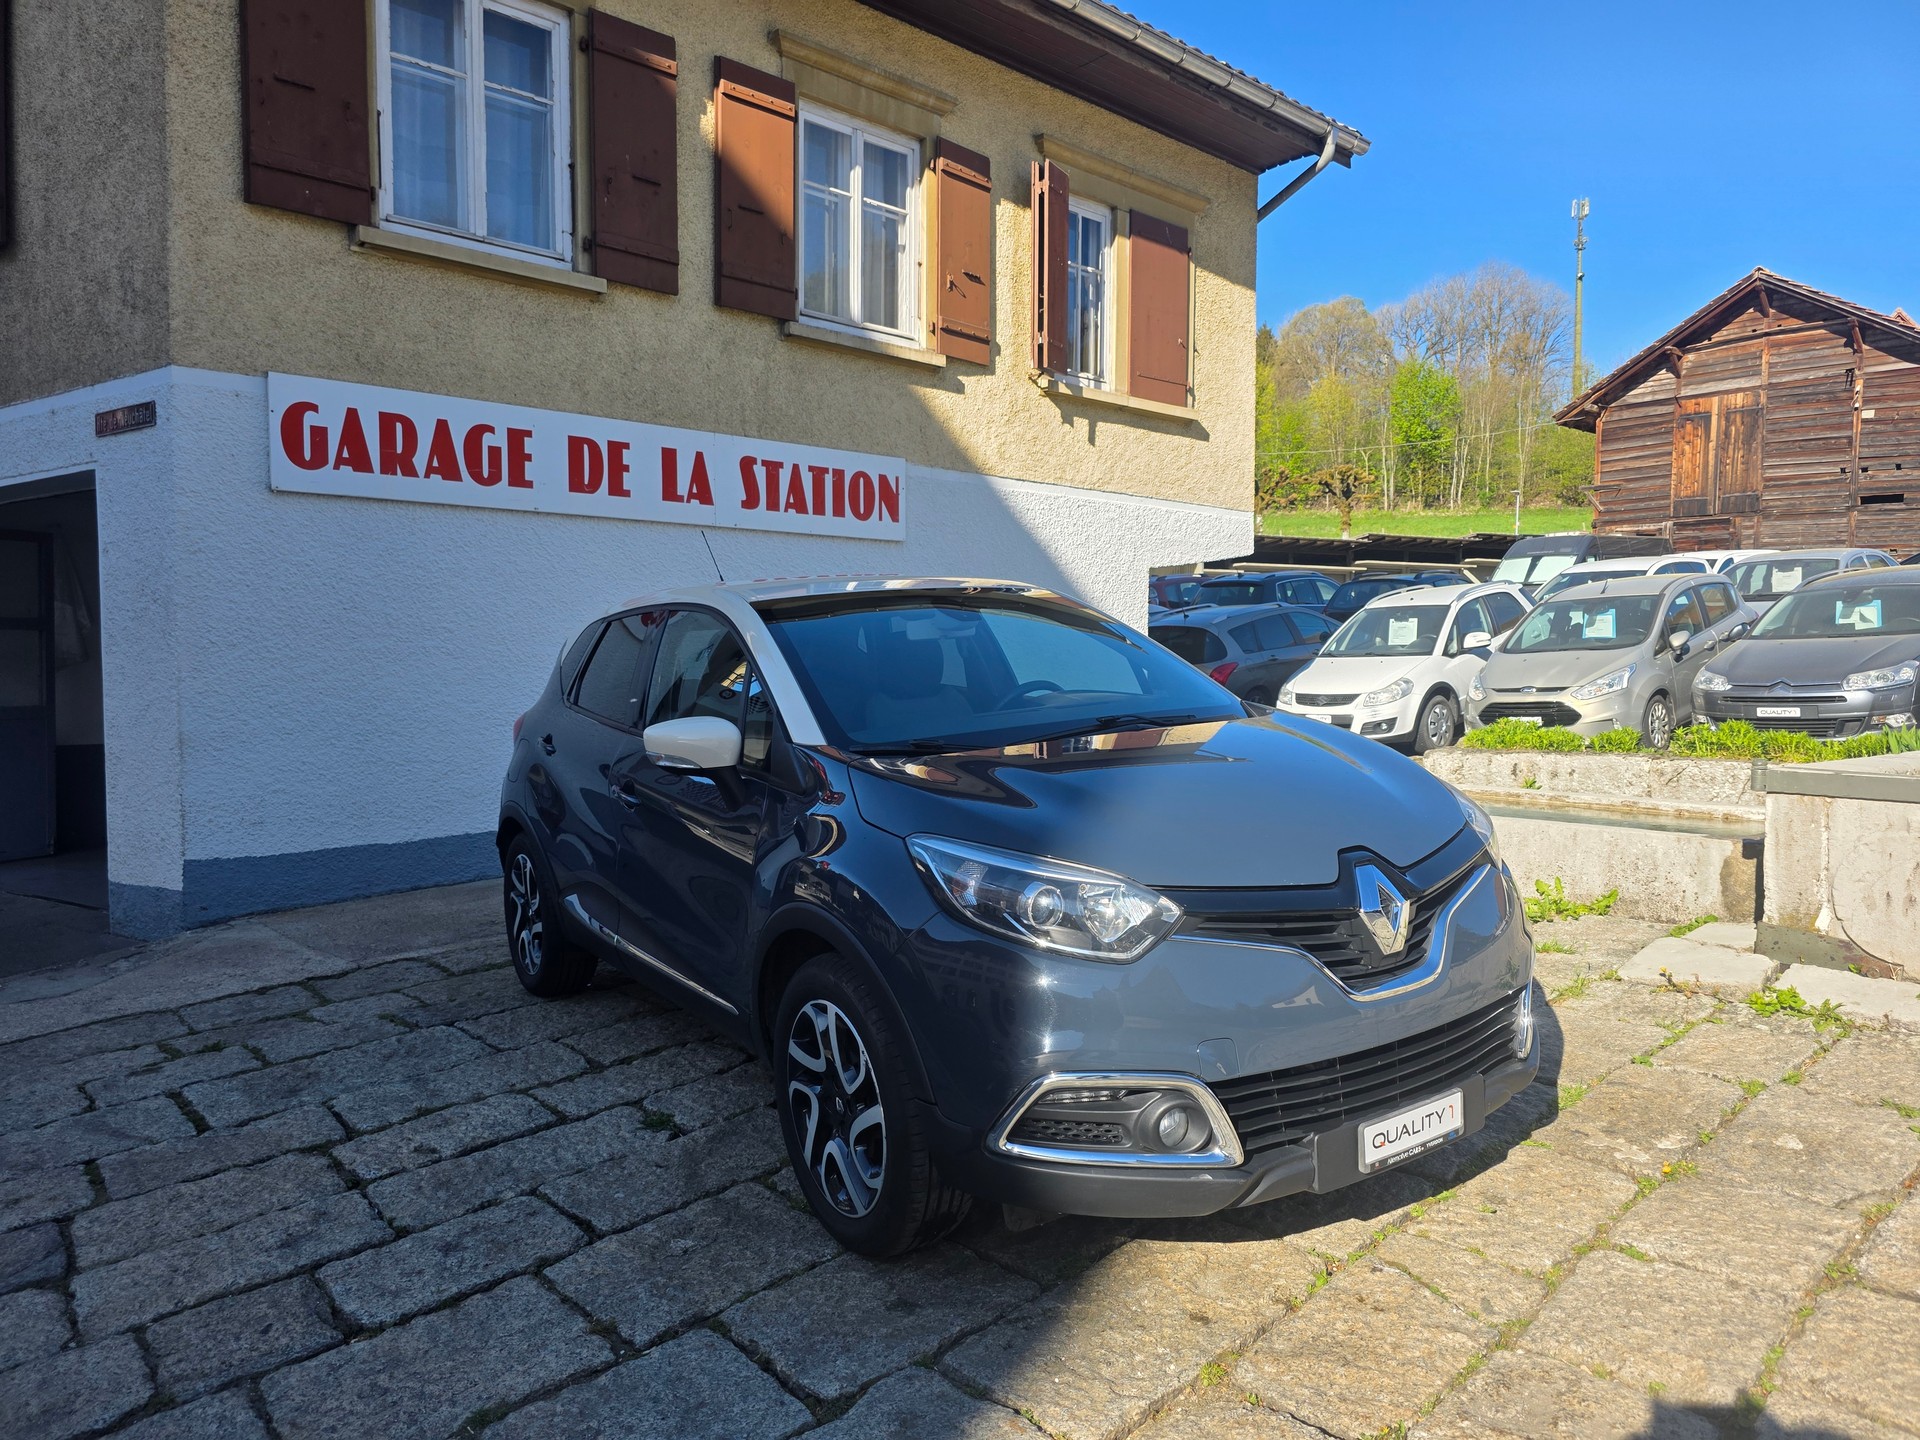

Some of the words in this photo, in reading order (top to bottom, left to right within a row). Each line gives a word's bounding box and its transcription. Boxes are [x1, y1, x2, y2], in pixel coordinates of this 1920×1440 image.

[280, 401, 534, 488] GARAGE
[567, 435, 631, 498] DE
[661, 447, 715, 506] LA
[739, 455, 900, 523] STATION
[1372, 1107, 1446, 1149] QUALITY
